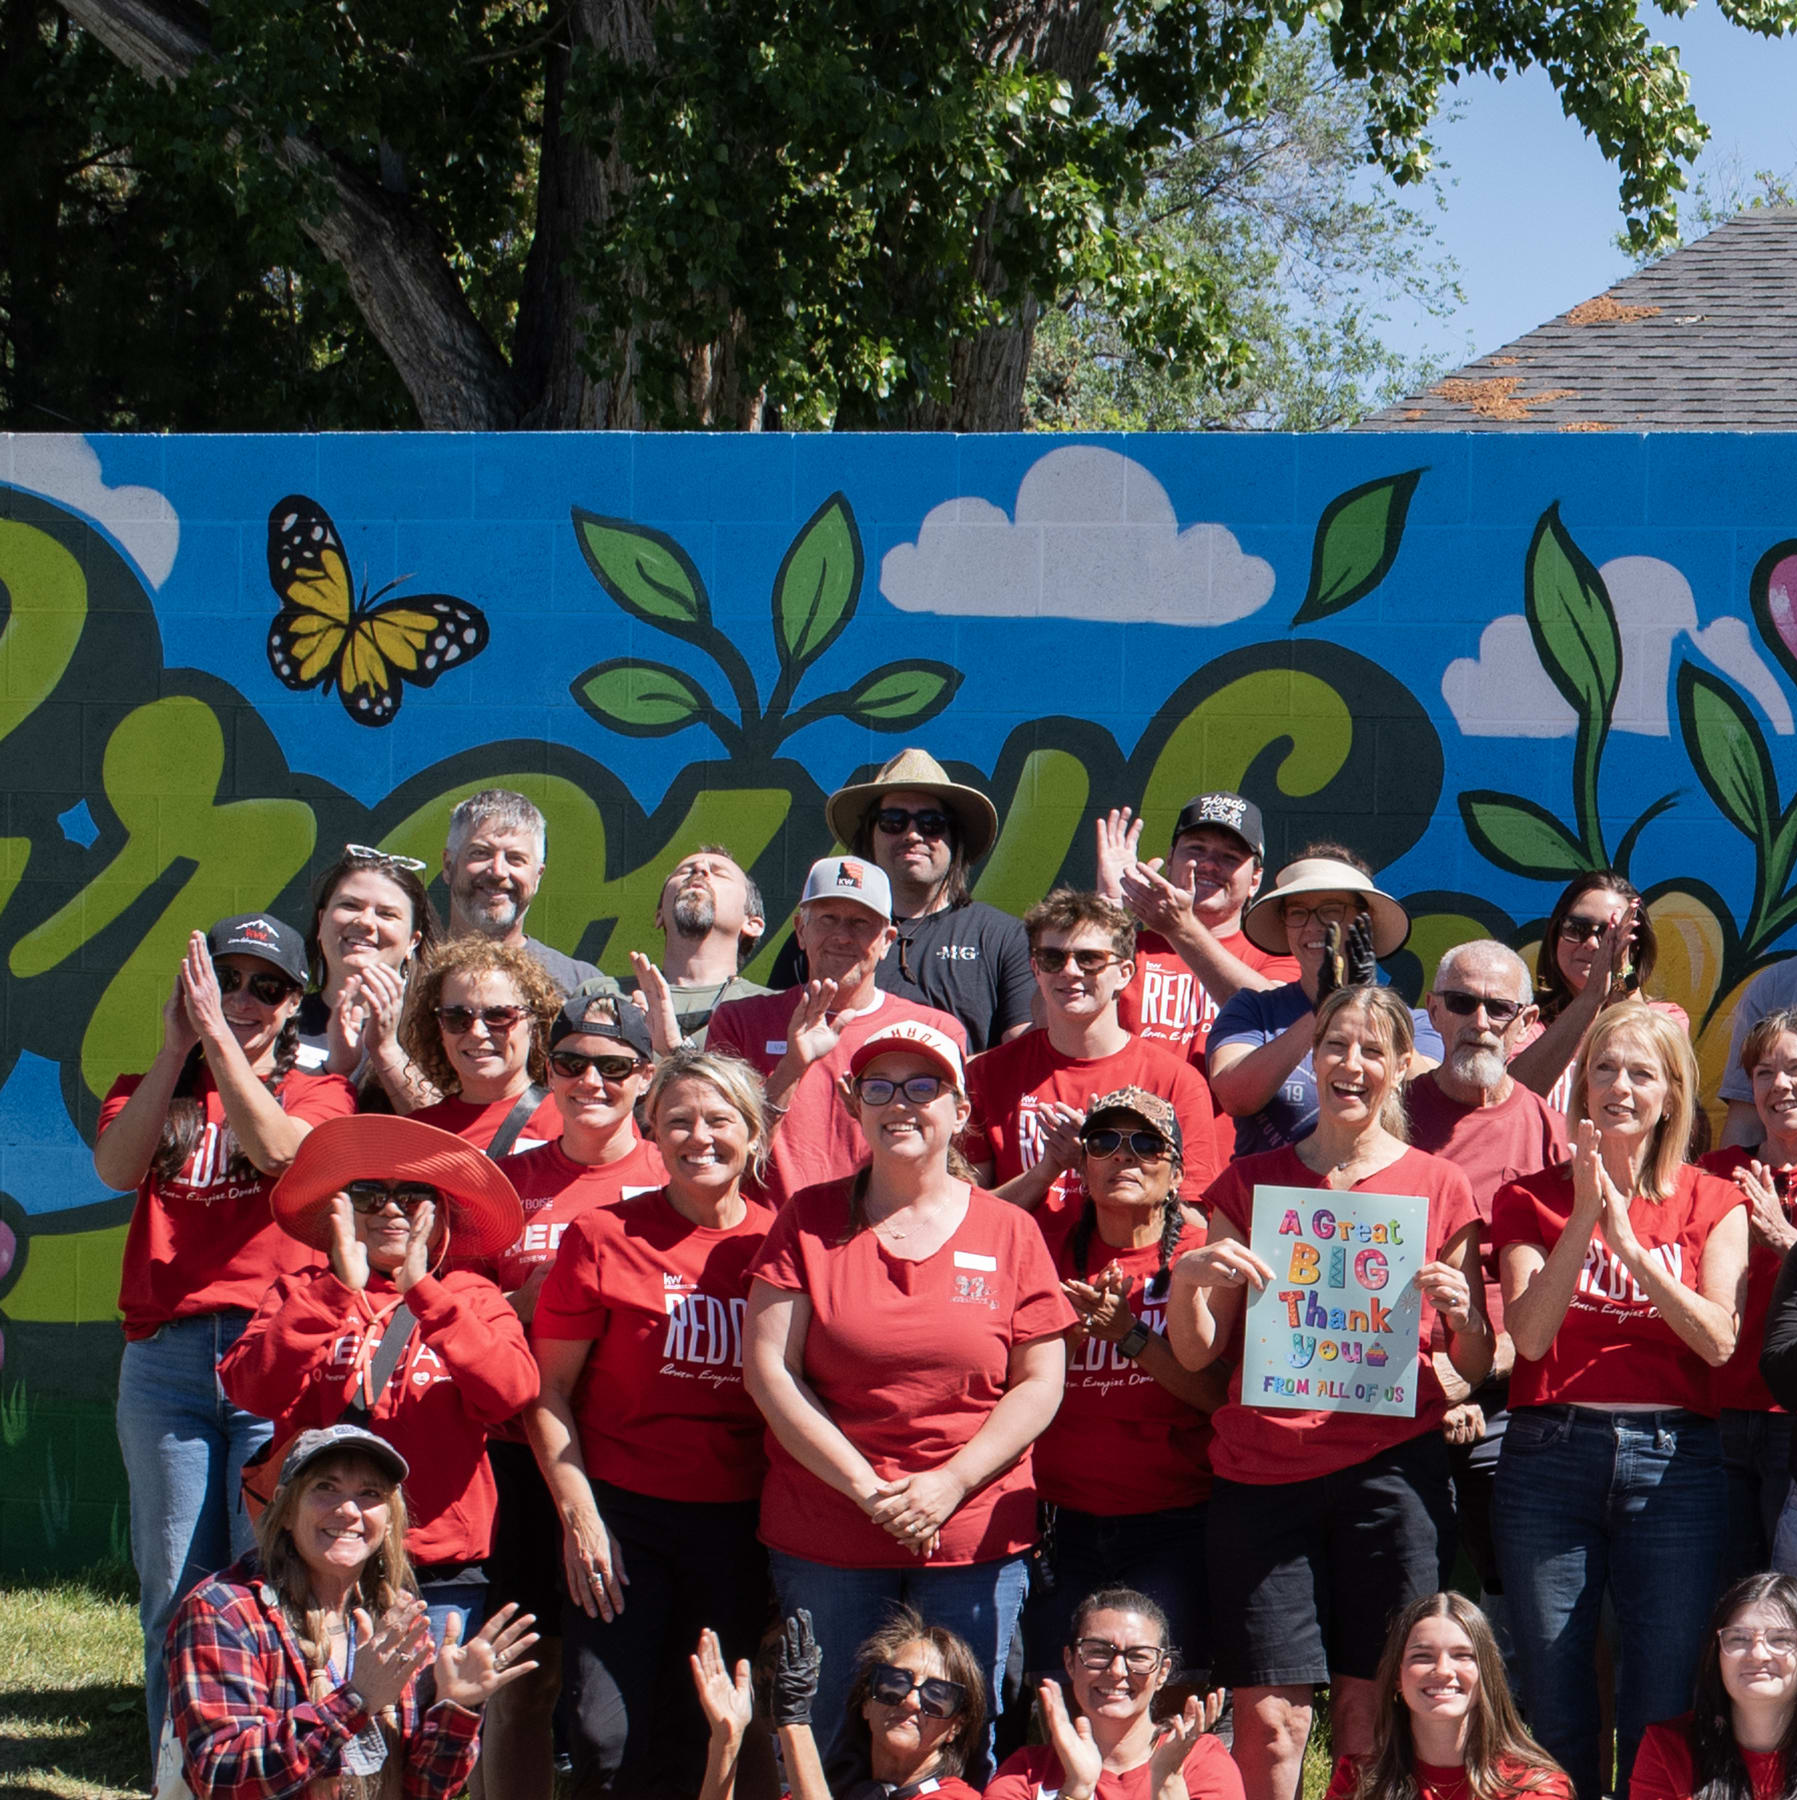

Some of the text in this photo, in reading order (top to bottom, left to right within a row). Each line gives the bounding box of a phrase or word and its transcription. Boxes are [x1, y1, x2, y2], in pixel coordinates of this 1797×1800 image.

[838, 878, 855, 887] KW
[1141, 971, 1193, 1028] RED
[1285, 1085, 1303, 1102] 19
[1278, 1208, 1404, 1246] A Great
[663, 1272, 682, 1285] kw
[1288, 1241, 1389, 1290] BIG
[663, 1293, 728, 1365] RED
[1278, 1290, 1393, 1334] Thank
[1285, 1333, 1363, 1369] you
[1263, 1375, 1405, 1403] FROM ALL OF US
